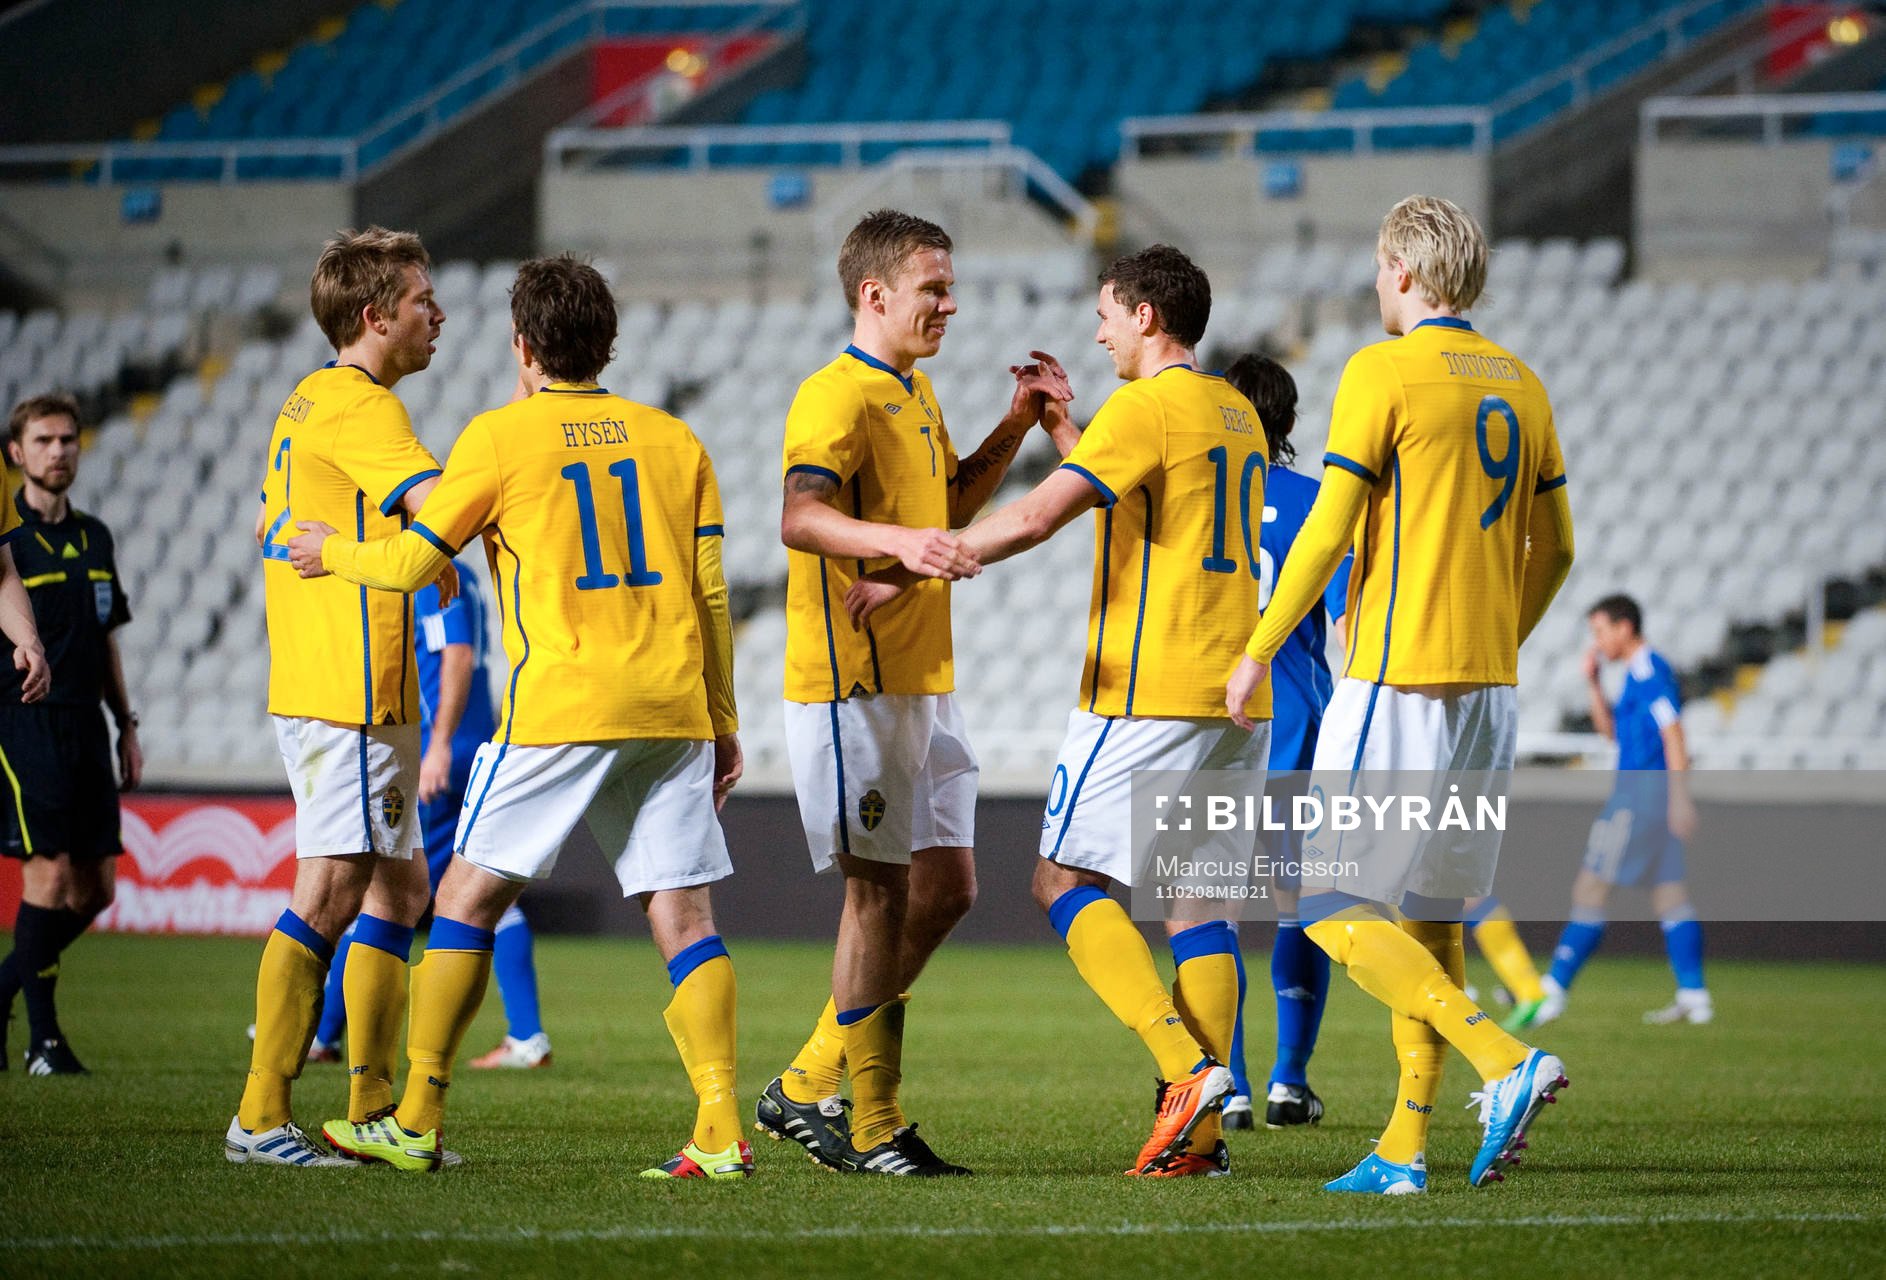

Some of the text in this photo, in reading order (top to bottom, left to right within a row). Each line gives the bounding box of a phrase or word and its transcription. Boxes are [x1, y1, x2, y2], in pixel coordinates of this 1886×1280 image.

[1441, 351, 1521, 381] TOIVONEN
[561, 417, 629, 447] HYSÉN
[919, 426, 936, 477] 7
[1219, 405, 1254, 435] BERG
[1475, 394, 1520, 531] 9
[263, 436, 292, 563] 2
[561, 458, 663, 590] 11
[1202, 445, 1267, 580] 10
